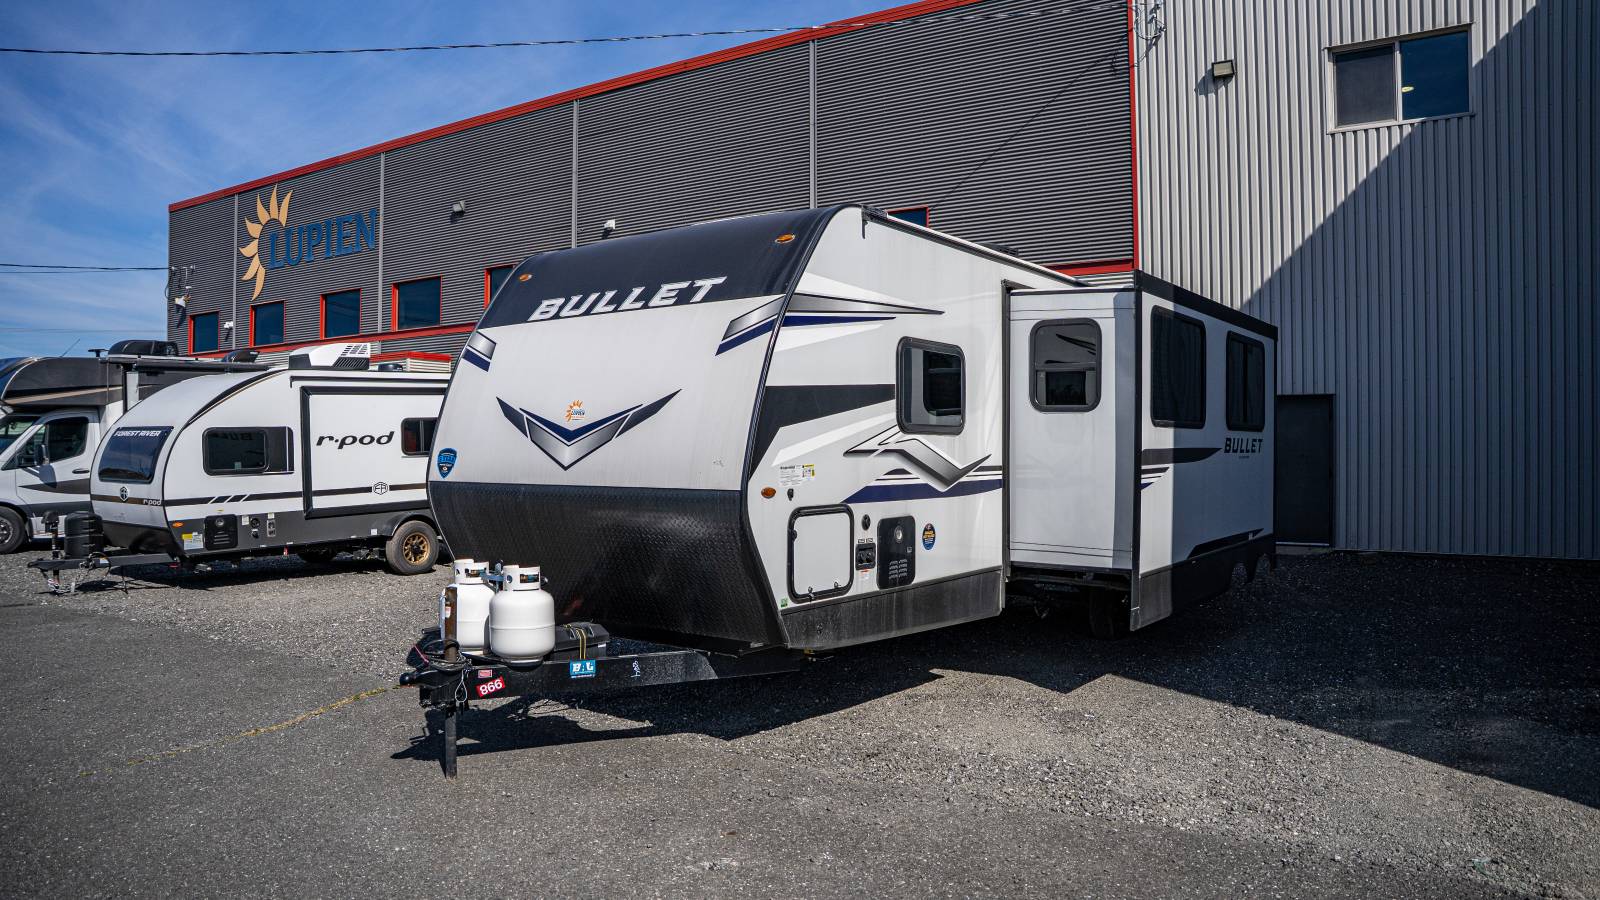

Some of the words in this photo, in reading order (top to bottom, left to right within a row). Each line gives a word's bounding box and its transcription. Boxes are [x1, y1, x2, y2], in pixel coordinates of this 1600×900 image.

[266, 208, 378, 270] LUPIEN
[527, 275, 728, 322] BULLET
[1224, 437, 1264, 454] BULLET
[479, 679, 503, 695] 866
